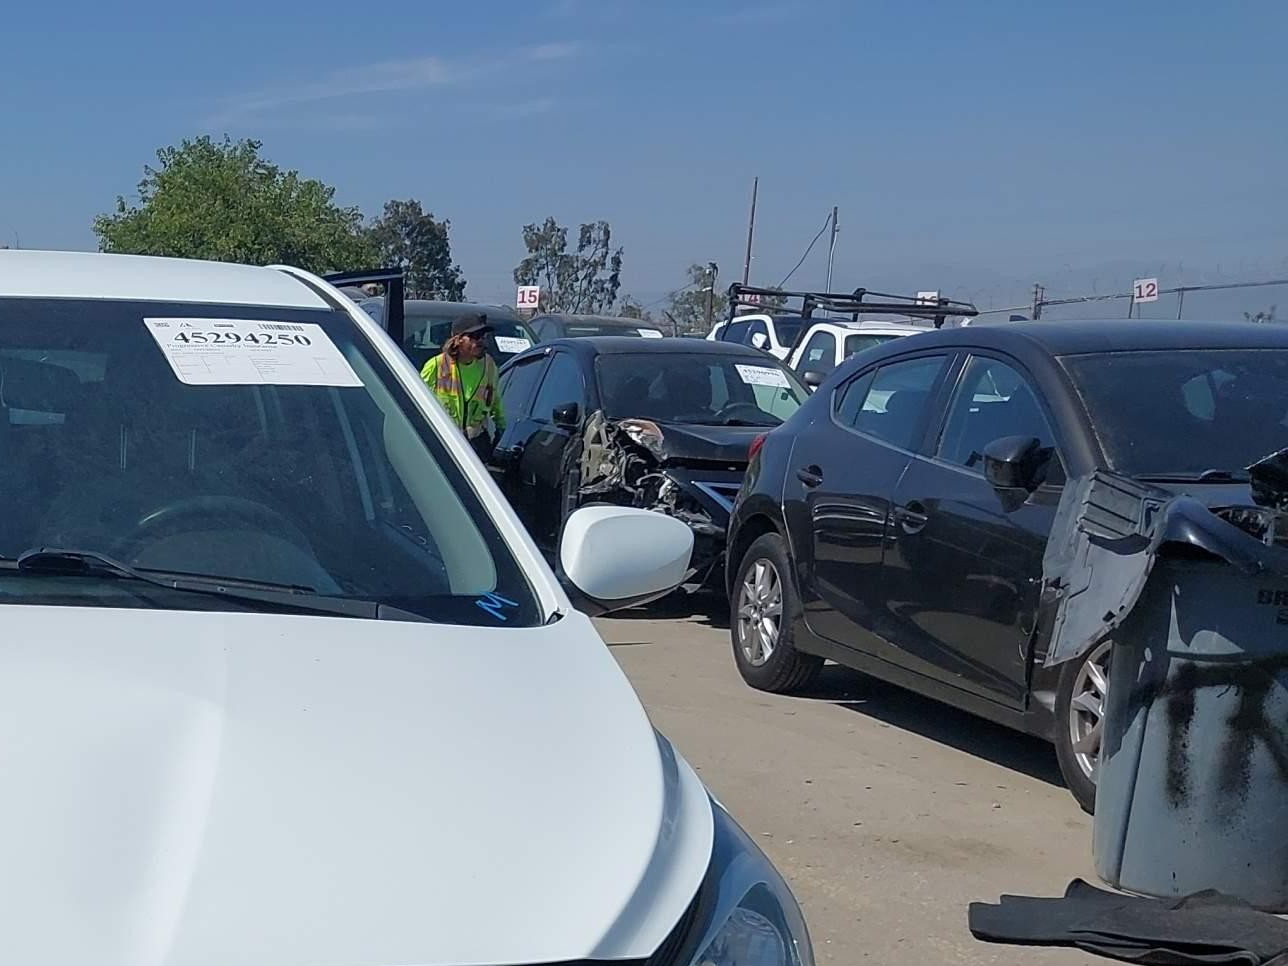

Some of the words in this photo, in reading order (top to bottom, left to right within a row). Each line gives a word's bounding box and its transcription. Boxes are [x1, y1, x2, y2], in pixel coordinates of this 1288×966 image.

[518, 289, 538, 304] 15
[1135, 282, 1157, 299] 12
[173, 331, 312, 347] 45294250
